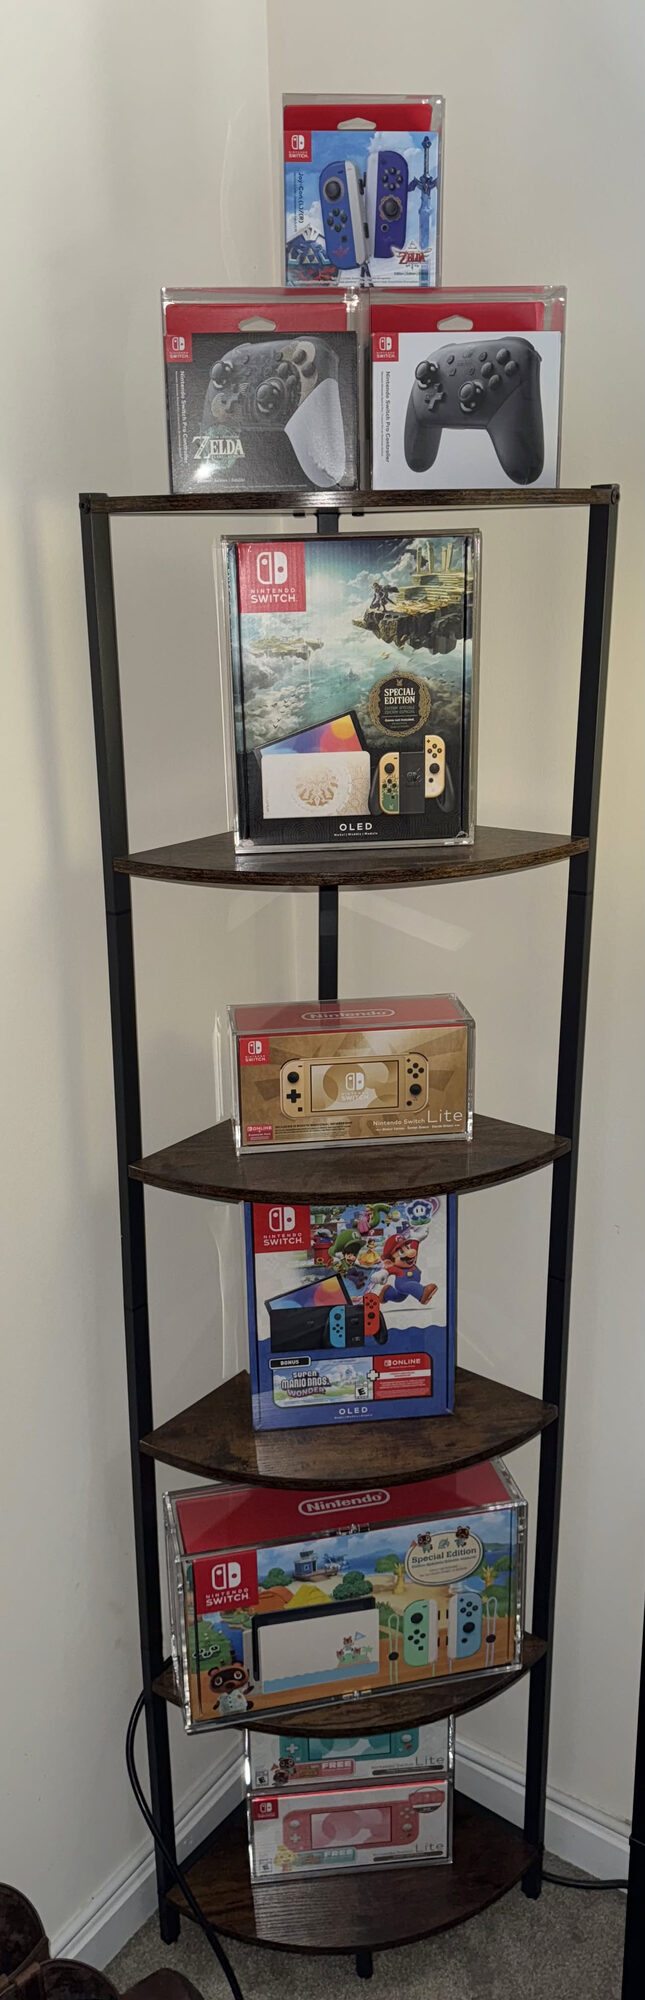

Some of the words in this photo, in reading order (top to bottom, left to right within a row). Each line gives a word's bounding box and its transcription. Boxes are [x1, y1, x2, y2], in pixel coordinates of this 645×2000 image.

[191, 435, 246, 460] ZELDA
[250, 594, 296, 604] SWITCH
[384, 687, 416, 697] SPECIAL
[384, 696, 416, 705] EDITION
[339, 822, 373, 832] OLED
[309, 1010, 387, 1019] Nintendo
[372, 1119, 402, 1127] Nintendo
[427, 1109, 463, 1123] Lite
[263, 1237, 303, 1246] SWITCH
[392, 1358, 421, 1366] ONLINE
[292, 1371, 318, 1379] SUPER
[281, 1378, 306, 1390] MARIO
[287, 1387, 326, 1397] WONDER
[338, 1406, 369, 1415] OLED
[306, 1493, 382, 1513] Nintendo
[411, 1552, 444, 1564] Special
[446, 1548, 477, 1558] Edition
[205, 1588, 249, 1599] NINTENDO
[205, 1592, 249, 1606] SWITCH
[321, 1760, 352, 1769] FREE
[415, 1755, 445, 1766] Lite
